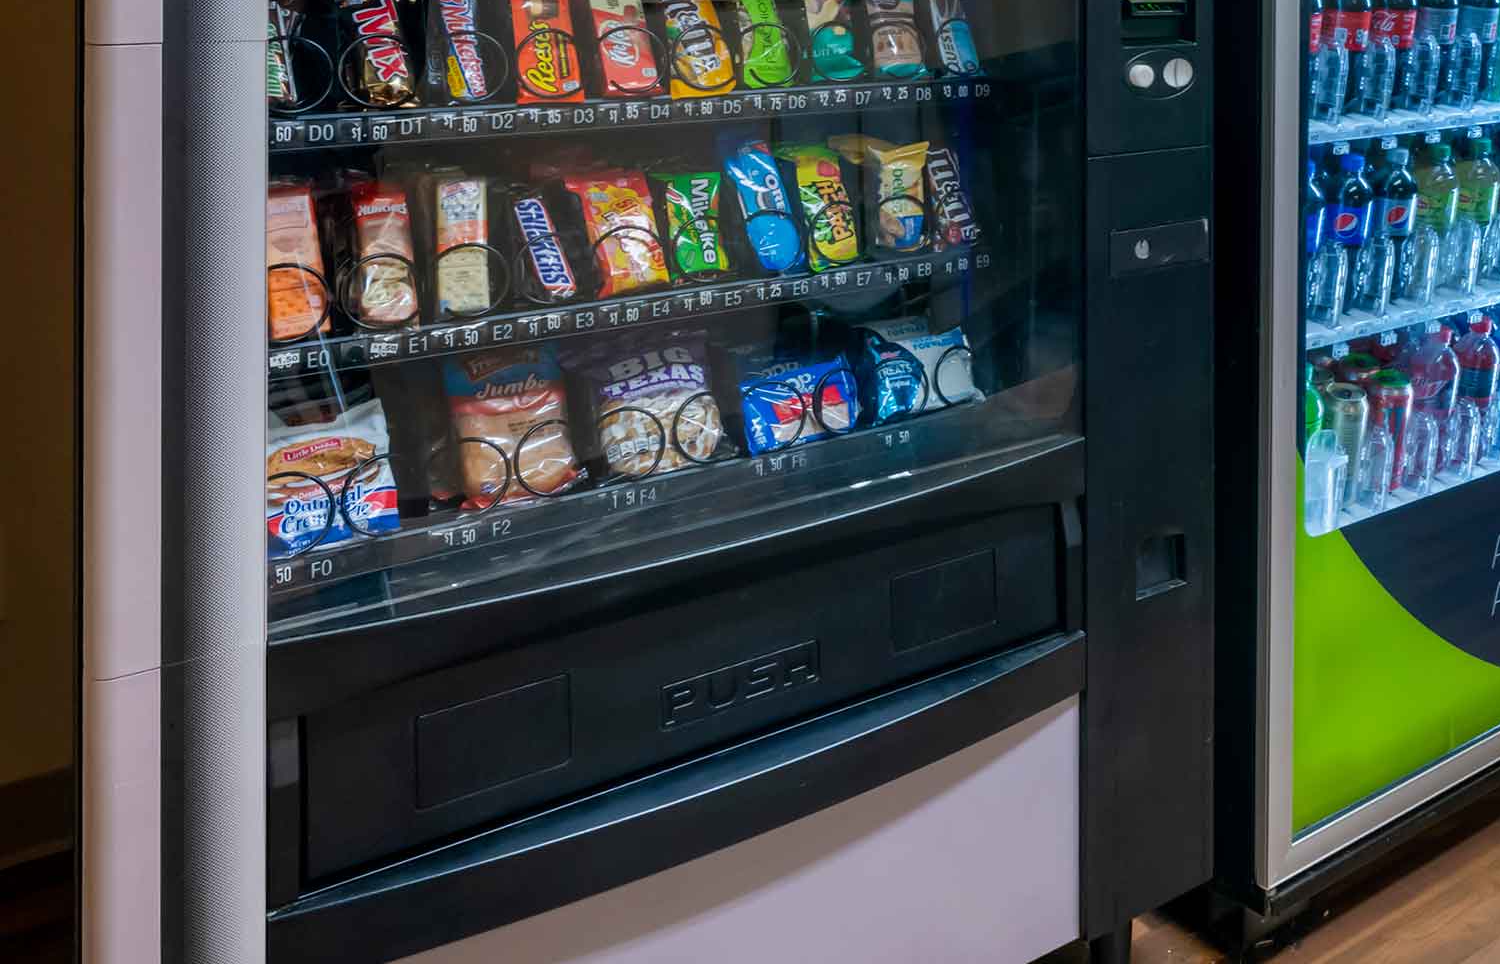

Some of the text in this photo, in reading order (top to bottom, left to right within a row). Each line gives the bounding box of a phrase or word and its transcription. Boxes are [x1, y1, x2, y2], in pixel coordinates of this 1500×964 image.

[855, 90, 872, 106] D7
[915, 87, 932, 101] D8
[975, 83, 992, 97] D9
[723, 99, 742, 114] D5
[788, 93, 807, 109] D6
[573, 108, 595, 124] D3
[650, 103, 671, 119] D4
[492, 113, 514, 130] D2
[517, 199, 571, 286] SNICKERS
[976, 254, 990, 268] E9
[917, 262, 932, 277] E8
[856, 271, 872, 286] E7
[792, 280, 809, 296] E6
[724, 290, 742, 307] E5
[652, 301, 670, 317] E4
[575, 311, 594, 328] E3
[493, 323, 513, 341] E2
[409, 335, 429, 354] E1
[608, 347, 694, 381] BIG
[603, 364, 705, 397] TEXAS
[878, 367, 913, 380] TREATS
[476, 372, 546, 399] Jumbo
[286, 447, 311, 461] Little
[640, 487, 657, 505] F4
[444, 519, 512, 546] $1.50 F2
[275, 566, 292, 584] 50
[664, 660, 820, 725] PUSH
